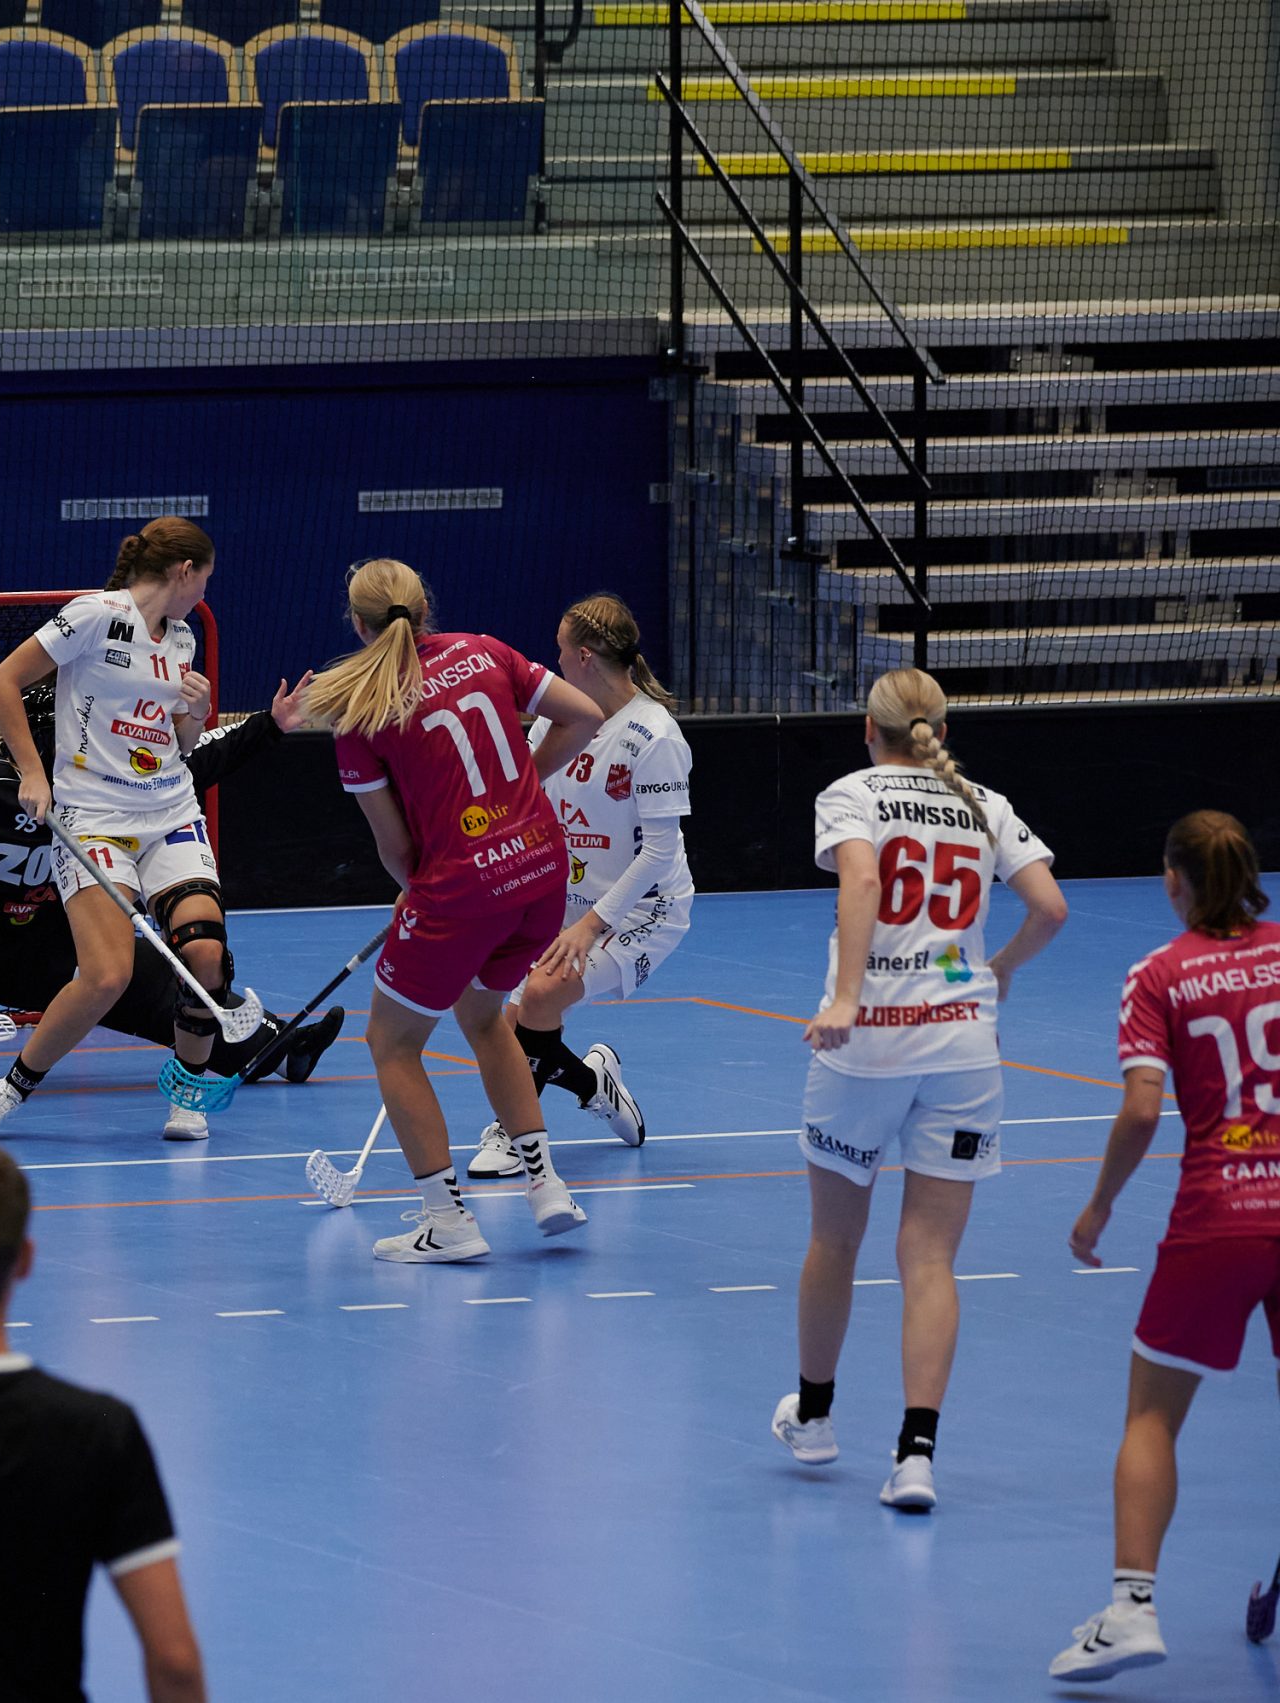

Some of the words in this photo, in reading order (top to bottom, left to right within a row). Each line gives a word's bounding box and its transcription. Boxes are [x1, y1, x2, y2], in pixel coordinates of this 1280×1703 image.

[150, 653, 170, 681] 11
[133, 699, 166, 724] ICA
[78, 695, 95, 754] mariehus
[118, 723, 170, 744] KVANTUM
[421, 692, 520, 797] 77
[14, 813, 37, 833] 95
[87, 847, 114, 868] 11
[480, 872, 492, 881] EL
[494, 862, 515, 876] TELE
[492, 886, 503, 896] VI
[503, 877, 521, 892] GÖR
[520, 861, 557, 884] SKILLNAD
[877, 836, 982, 931] 65
[866, 951, 929, 970] änerEl
